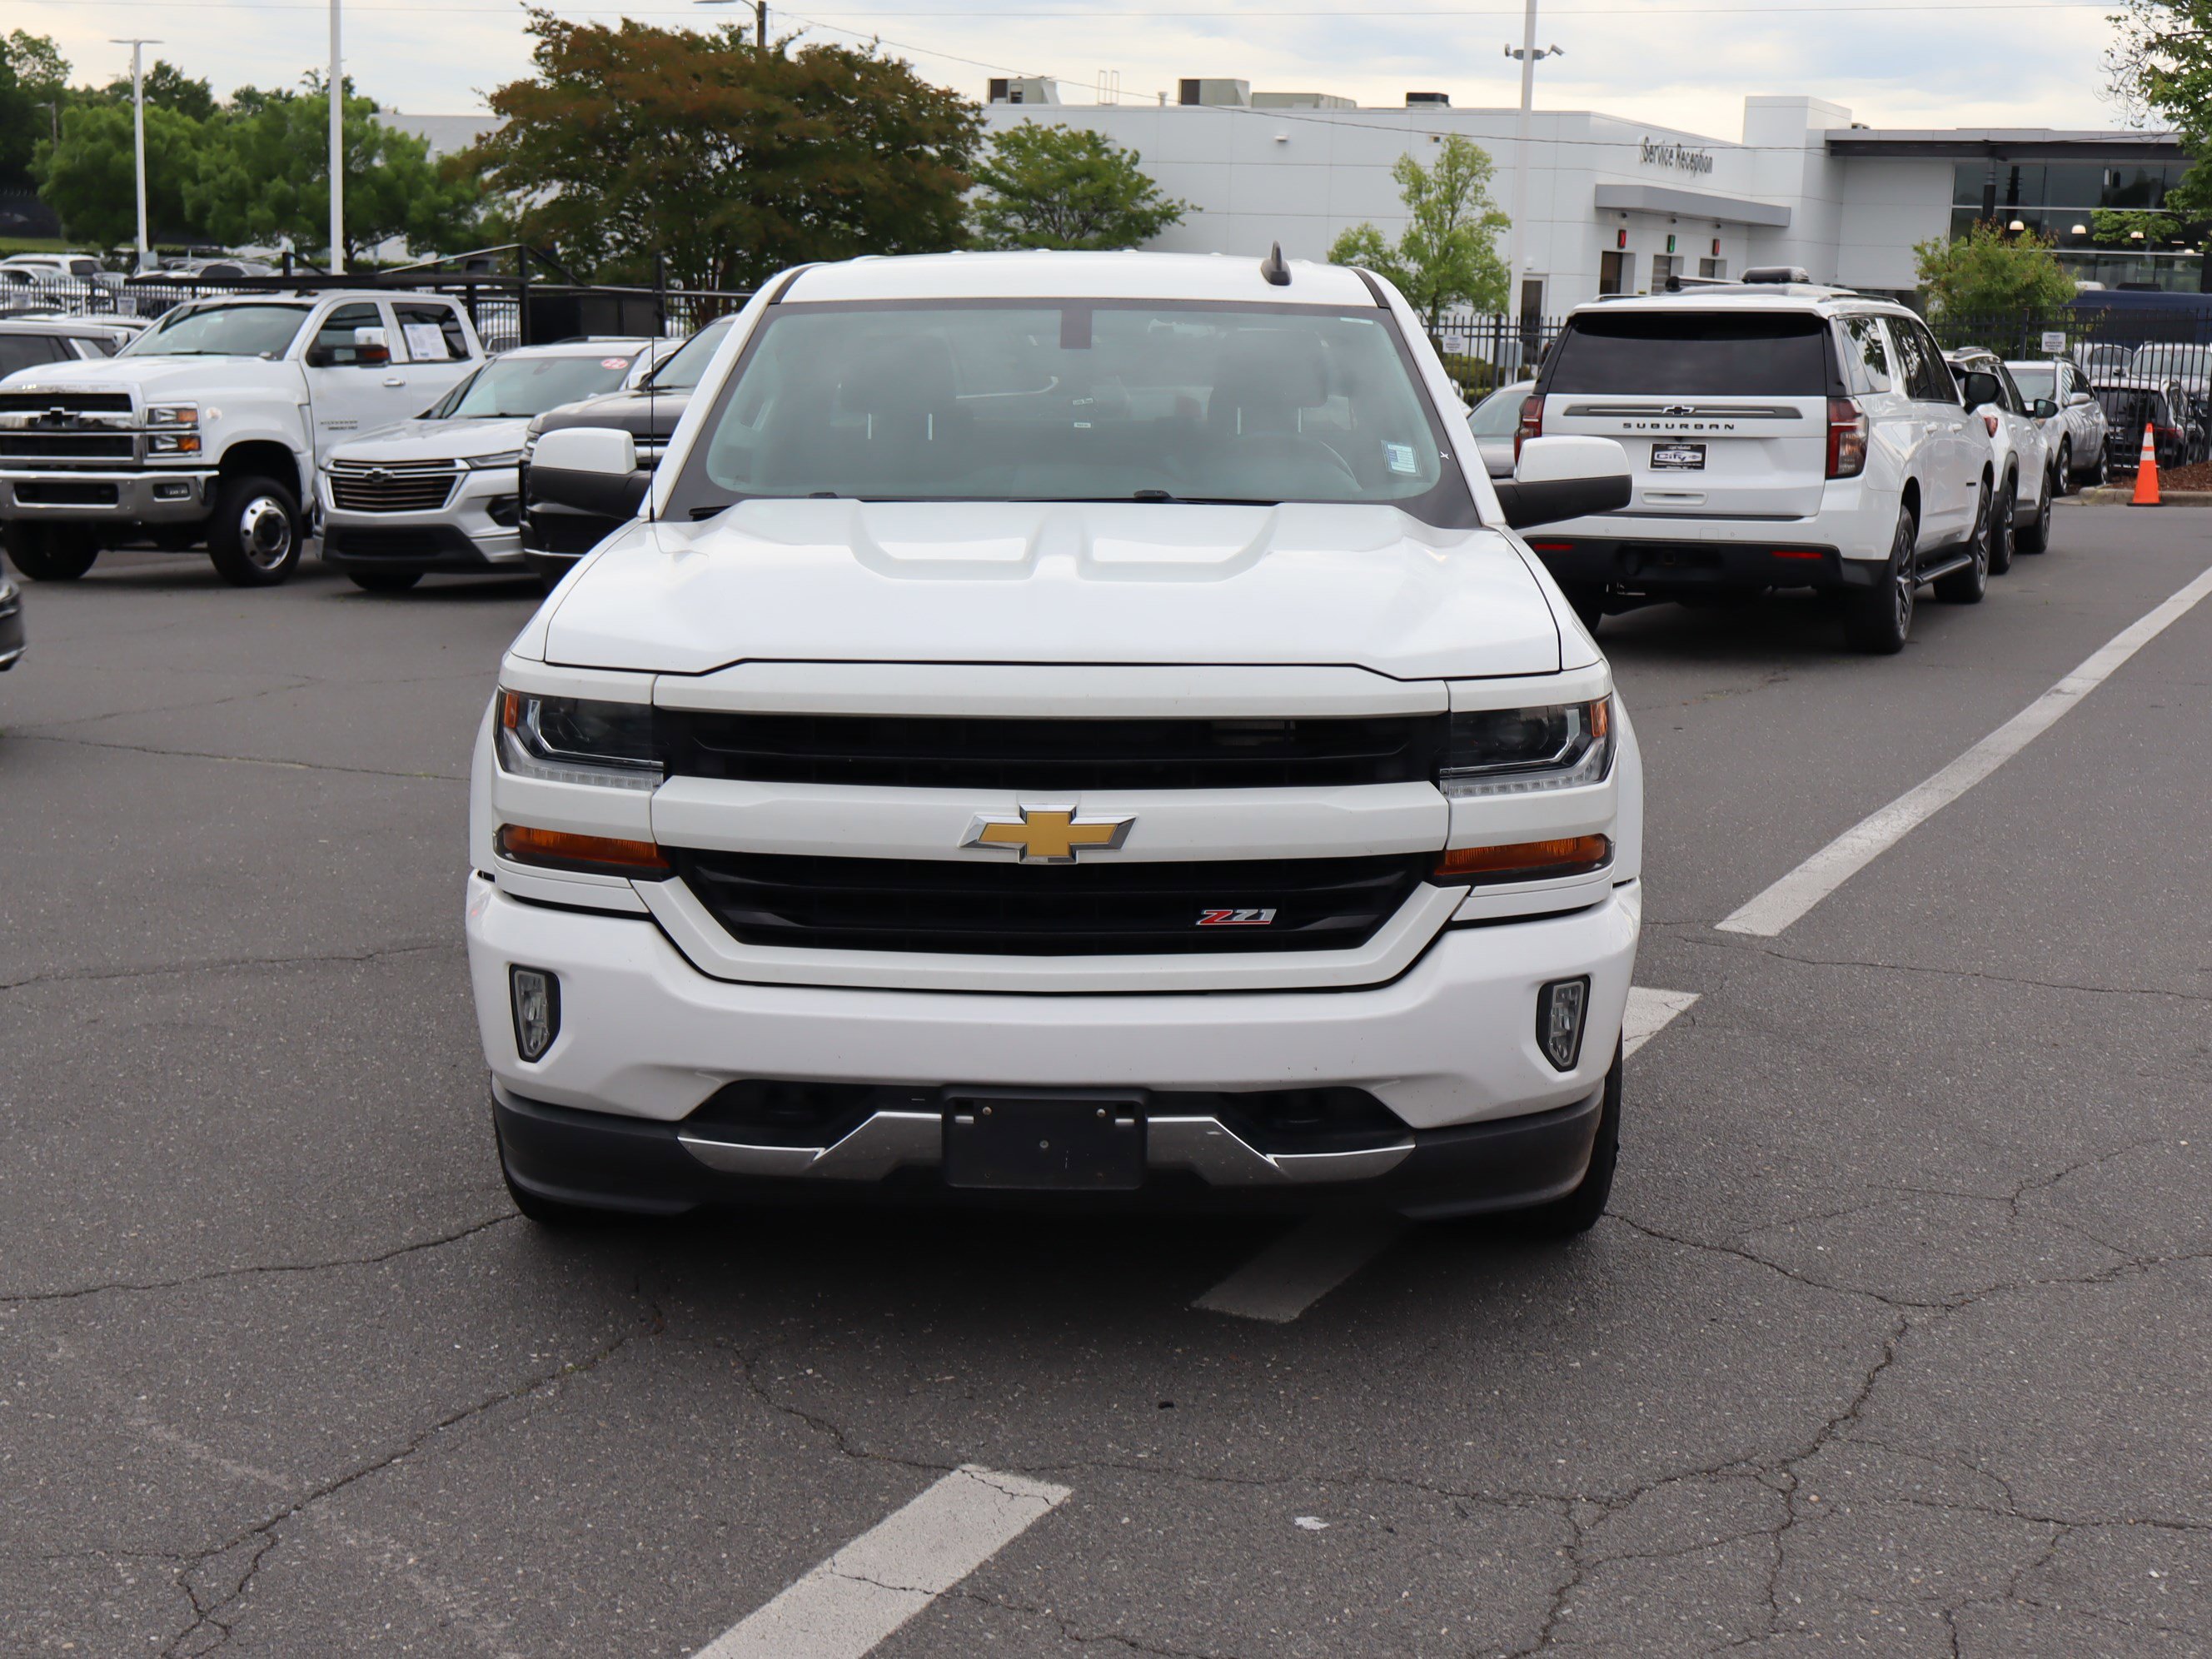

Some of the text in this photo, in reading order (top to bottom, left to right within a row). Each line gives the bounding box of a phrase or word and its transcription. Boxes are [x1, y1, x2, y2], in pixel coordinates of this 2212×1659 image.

[1640, 136, 1713, 177] Service Reception
[1195, 909, 1277, 925] Z71
